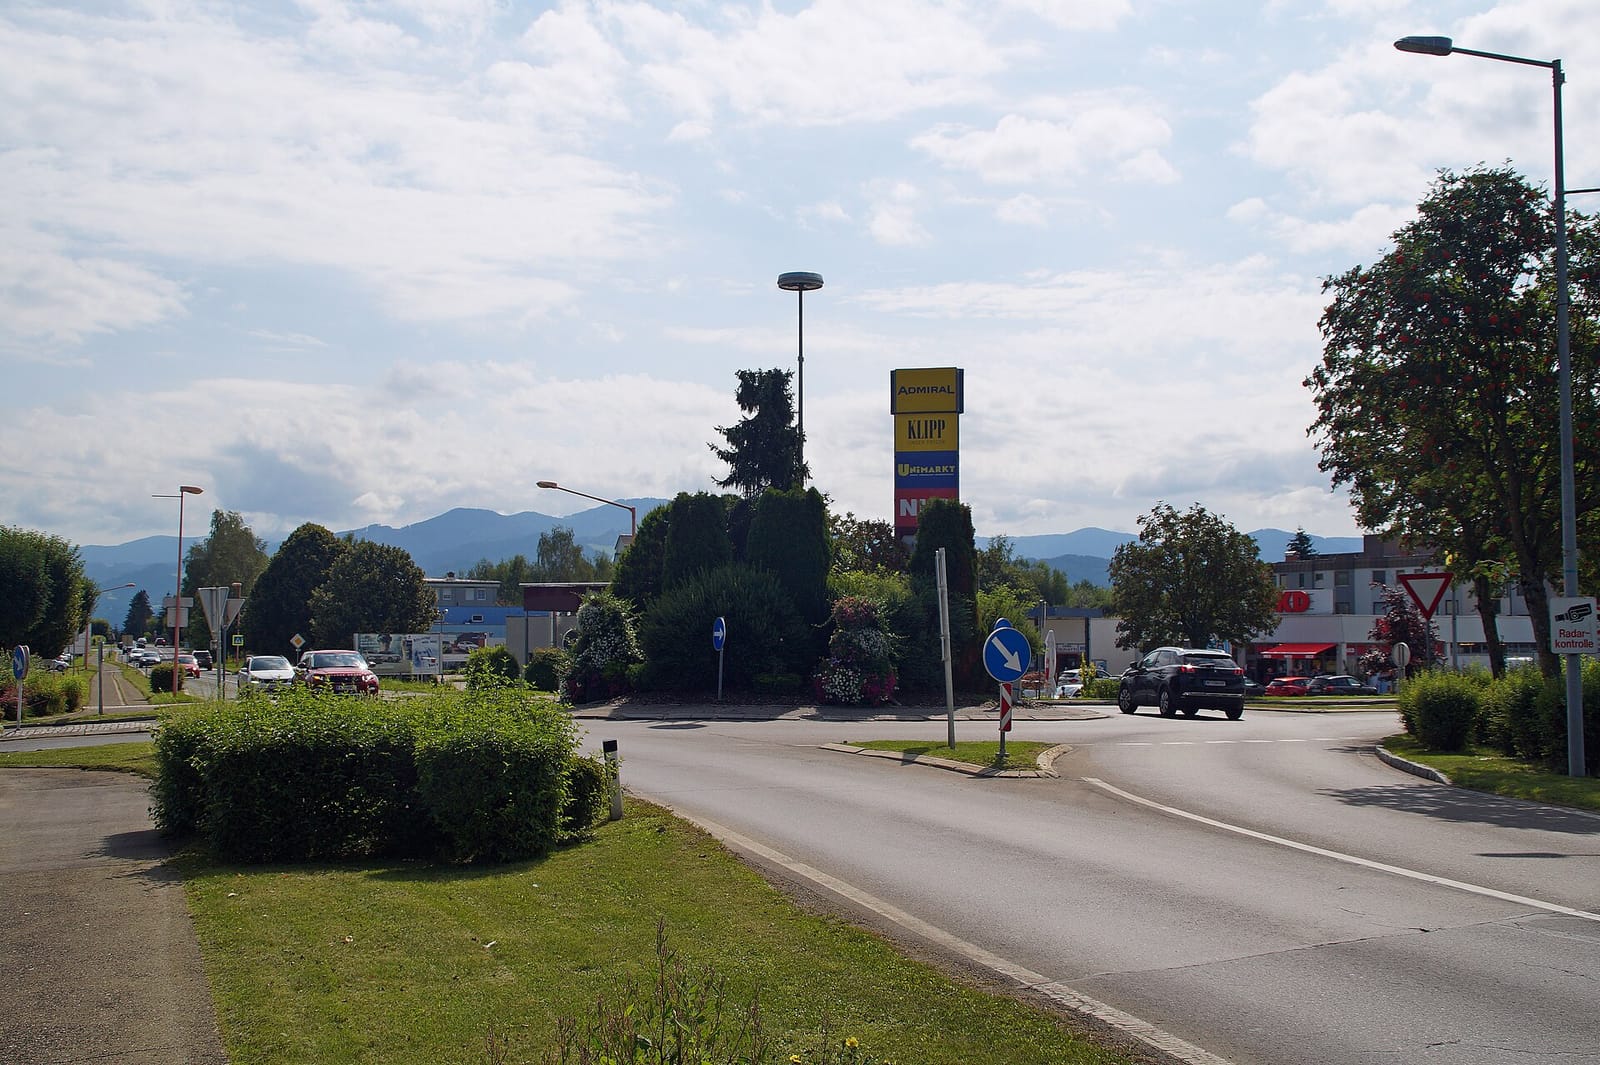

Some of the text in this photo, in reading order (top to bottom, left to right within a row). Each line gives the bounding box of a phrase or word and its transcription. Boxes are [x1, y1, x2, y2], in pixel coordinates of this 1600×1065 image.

[898, 385, 954, 395] ADMIRAL
[908, 419, 945, 439] KLIPP
[1559, 629, 1591, 638] Radar-
[1555, 640, 1594, 649] kontrolle
